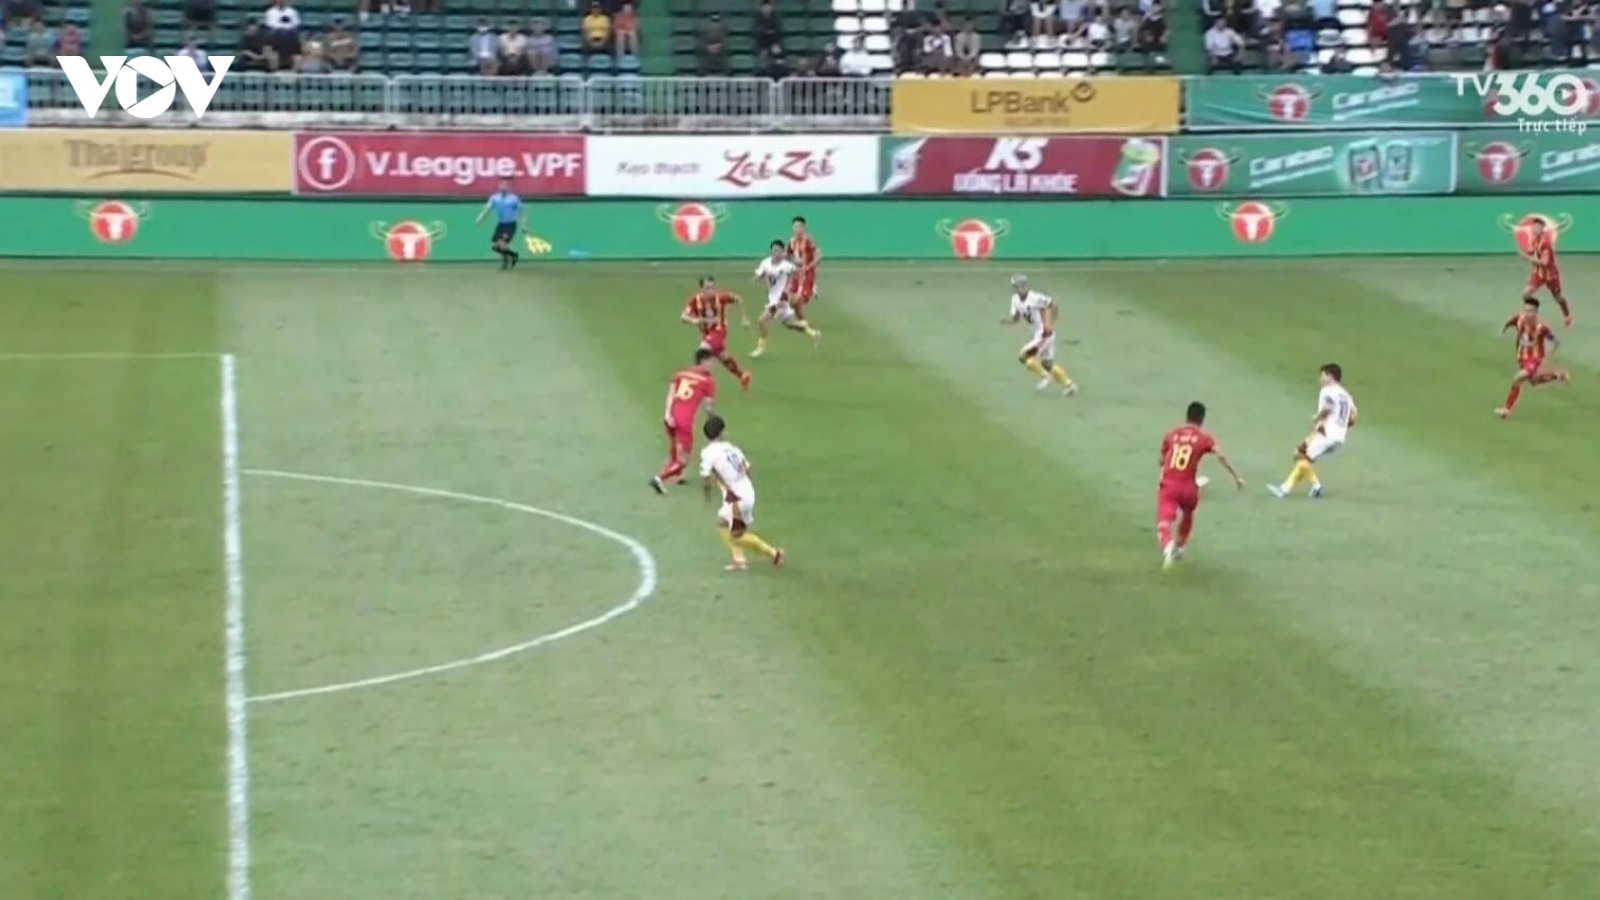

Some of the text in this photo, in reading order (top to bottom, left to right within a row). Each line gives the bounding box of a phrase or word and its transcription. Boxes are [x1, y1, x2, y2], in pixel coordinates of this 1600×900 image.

[970, 89, 1071, 114] LPBank
[365, 151, 583, 186] V.League.VPF
[1170, 443, 1192, 471] 18
